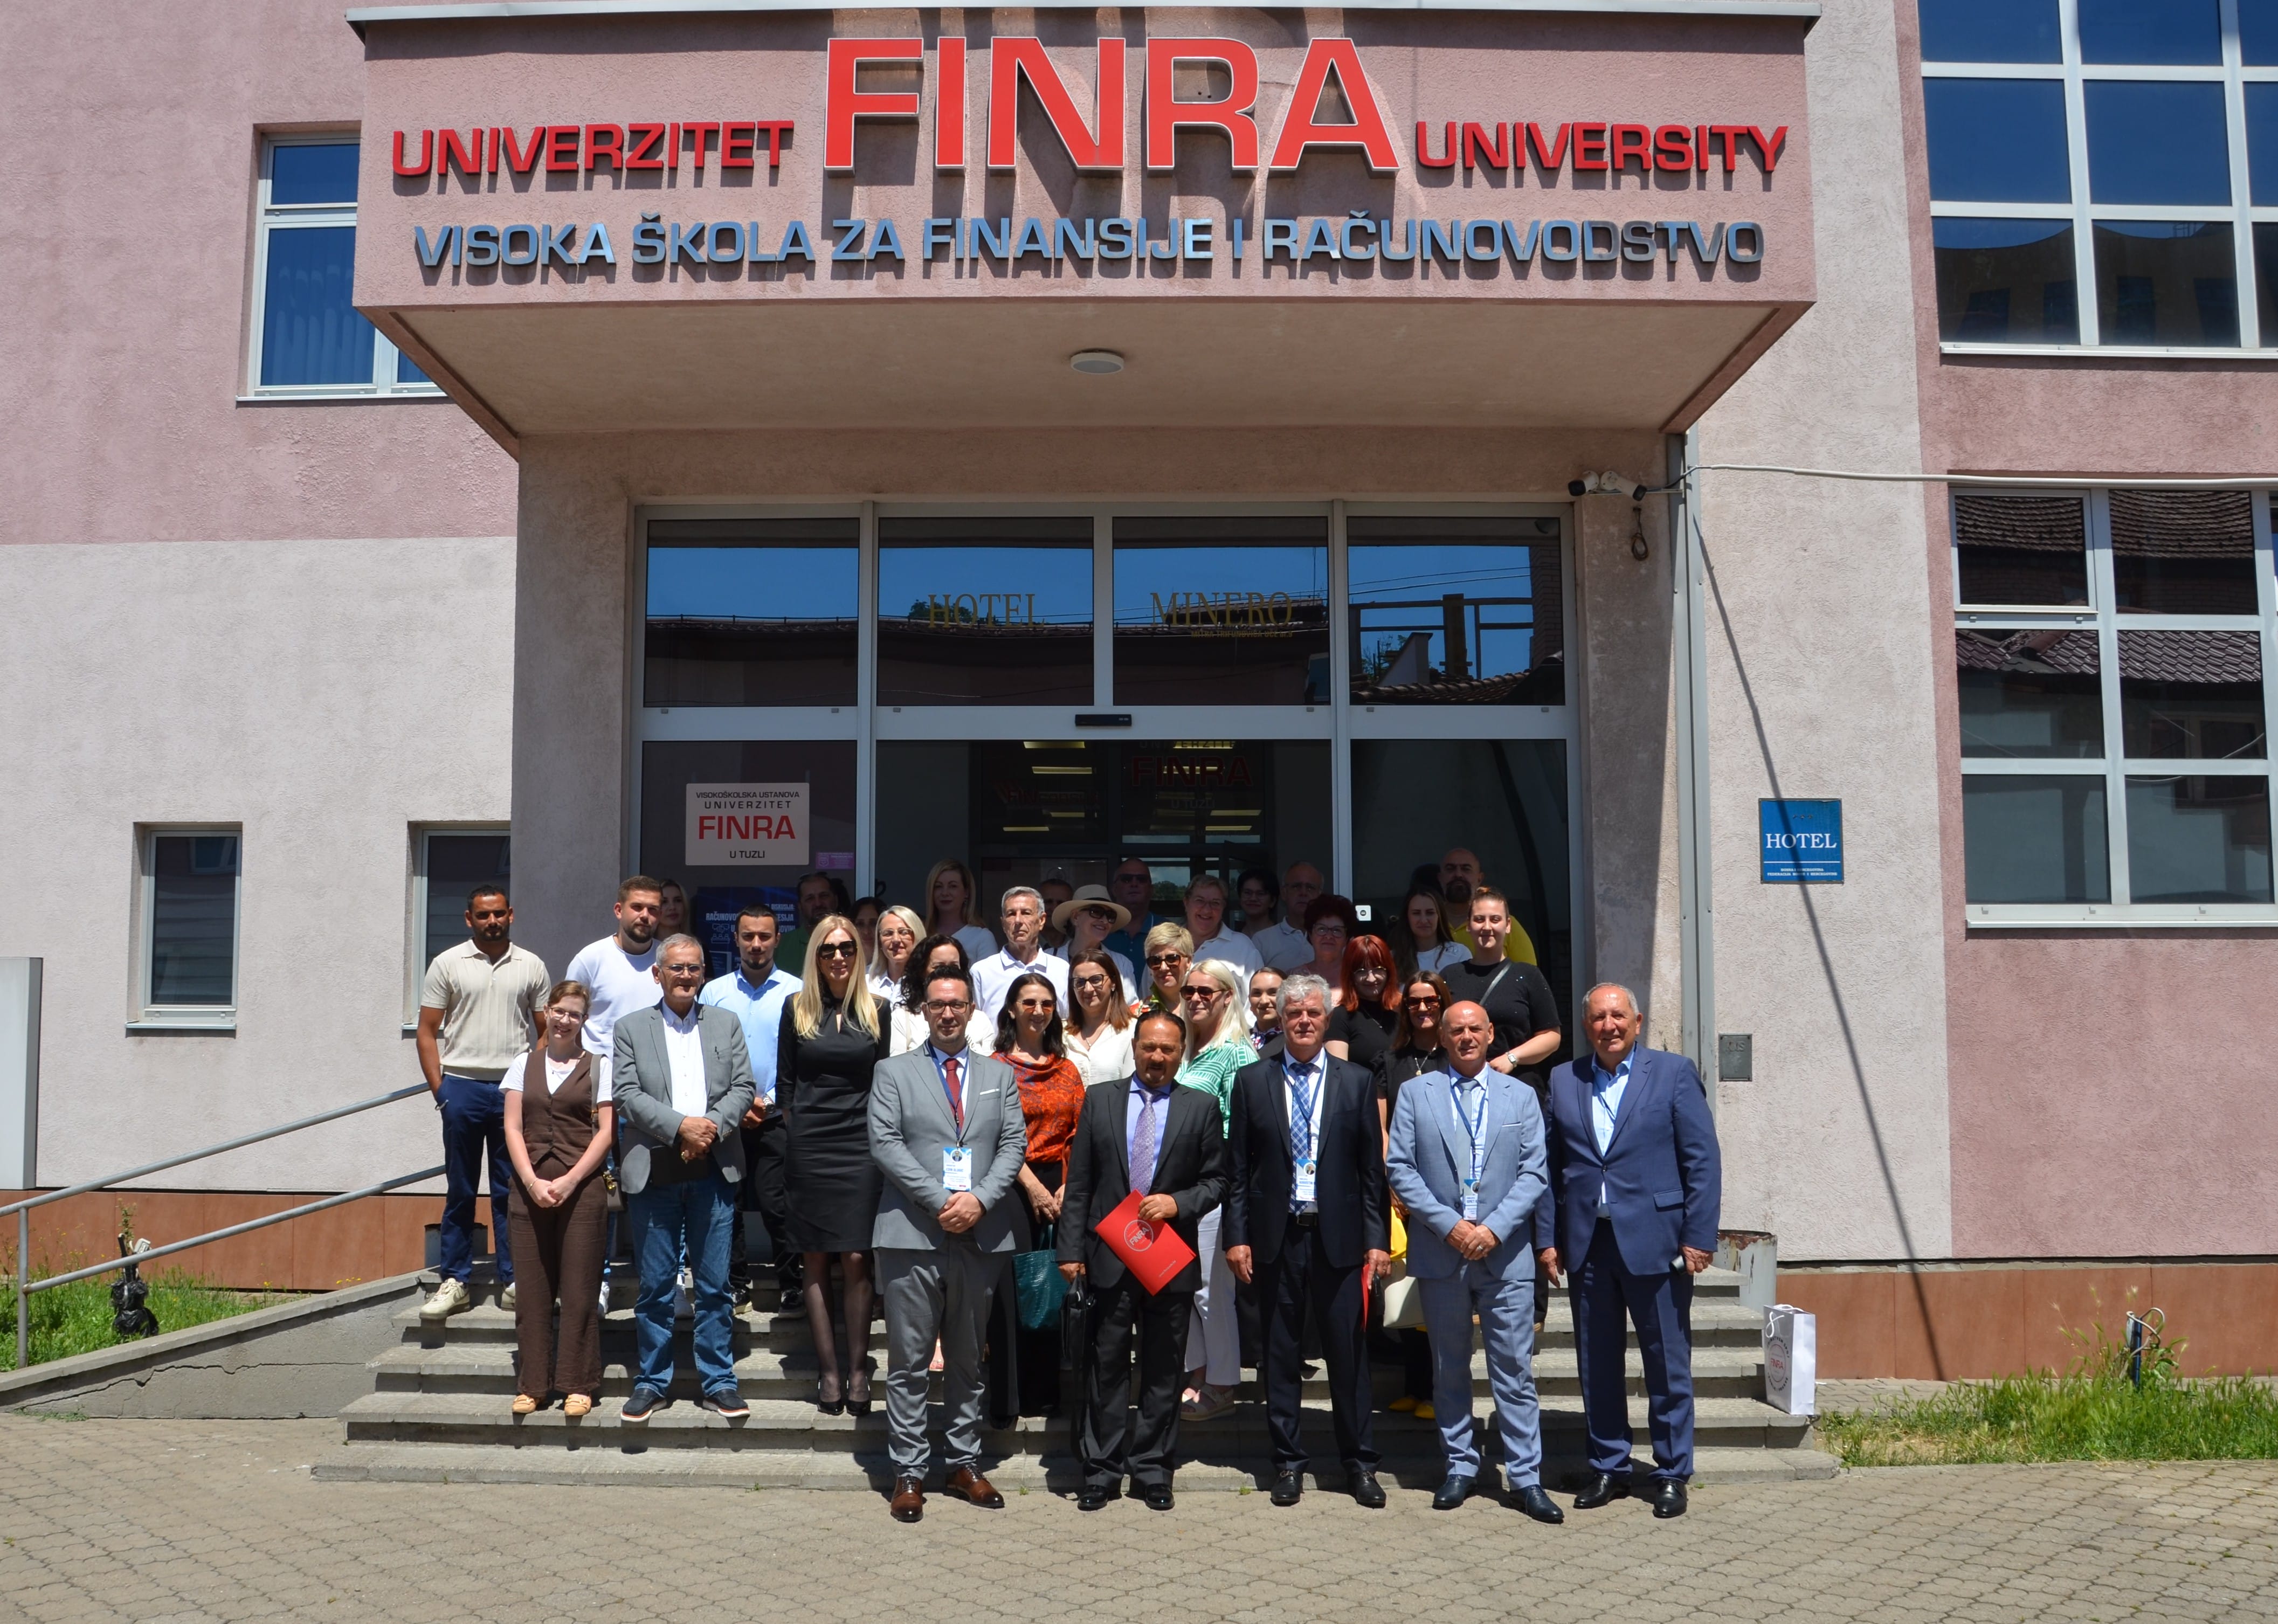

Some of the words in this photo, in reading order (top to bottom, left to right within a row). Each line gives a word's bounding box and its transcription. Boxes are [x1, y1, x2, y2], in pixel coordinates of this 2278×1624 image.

[392, 120, 794, 176] UNIVERZITET
[824, 36, 1400, 174] FINRA
[1416, 121, 1788, 172] UNIVERSITY
[415, 223, 616, 267] VISOKA
[632, 212, 815, 264] ŠKOLA
[831, 218, 905, 260] ZA
[922, 217, 1213, 260] FINANSIJE
[1232, 218, 1242, 260] I
[1264, 210, 1765, 264] RAČUNOVODSTVO
[928, 593, 1045, 628] HOTEL
[1150, 591, 1293, 626] MINERO
[1131, 756, 1253, 786] FINRA
[705, 801, 791, 809] UNIVERZITET
[699, 816, 796, 839] FINRA
[1765, 833, 1837, 848] HOTEL
[706, 911, 738, 921] RAČUNOVO
[1129, 1227, 1149, 1246] FINRA
